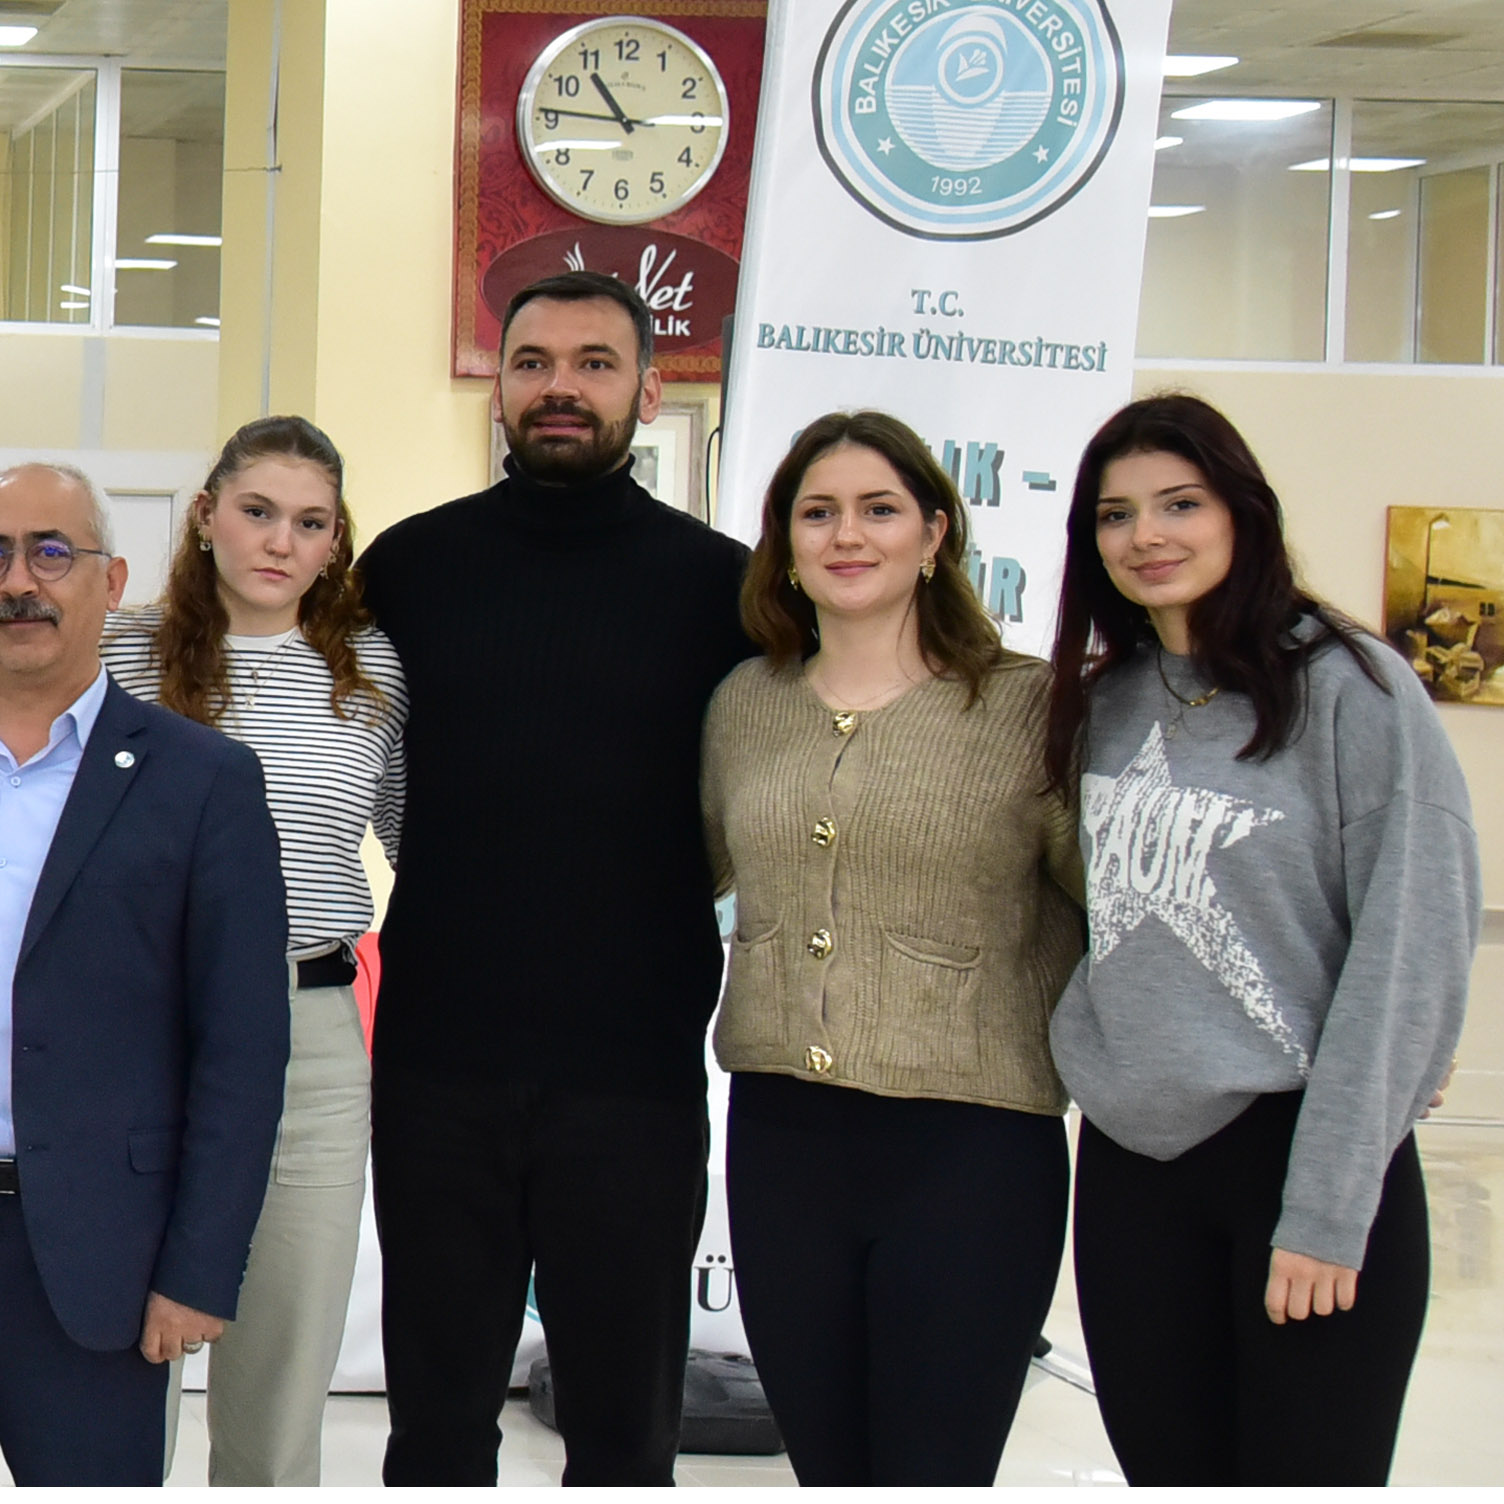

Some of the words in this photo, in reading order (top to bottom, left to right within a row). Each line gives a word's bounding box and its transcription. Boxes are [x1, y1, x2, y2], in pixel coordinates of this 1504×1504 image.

[579, 49, 600, 70] 11
[615, 39, 640, 61] 12
[657, 51, 667, 72] 1
[976, 0, 1081, 128] ERSİTESİ
[553, 75, 579, 97] 10
[681, 77, 697, 99] 2
[544, 109, 559, 130] 9
[555, 146, 570, 165] 8
[677, 146, 693, 168] 4
[580, 169, 594, 191] 7
[615, 179, 629, 200] 6
[649, 172, 665, 193] 5
[931, 175, 983, 196] 1992
[911, 289, 964, 317] T.C.
[757, 323, 906, 358] BALIKESİR
[912, 328, 1108, 372] ÜNİVERSİTESİ
